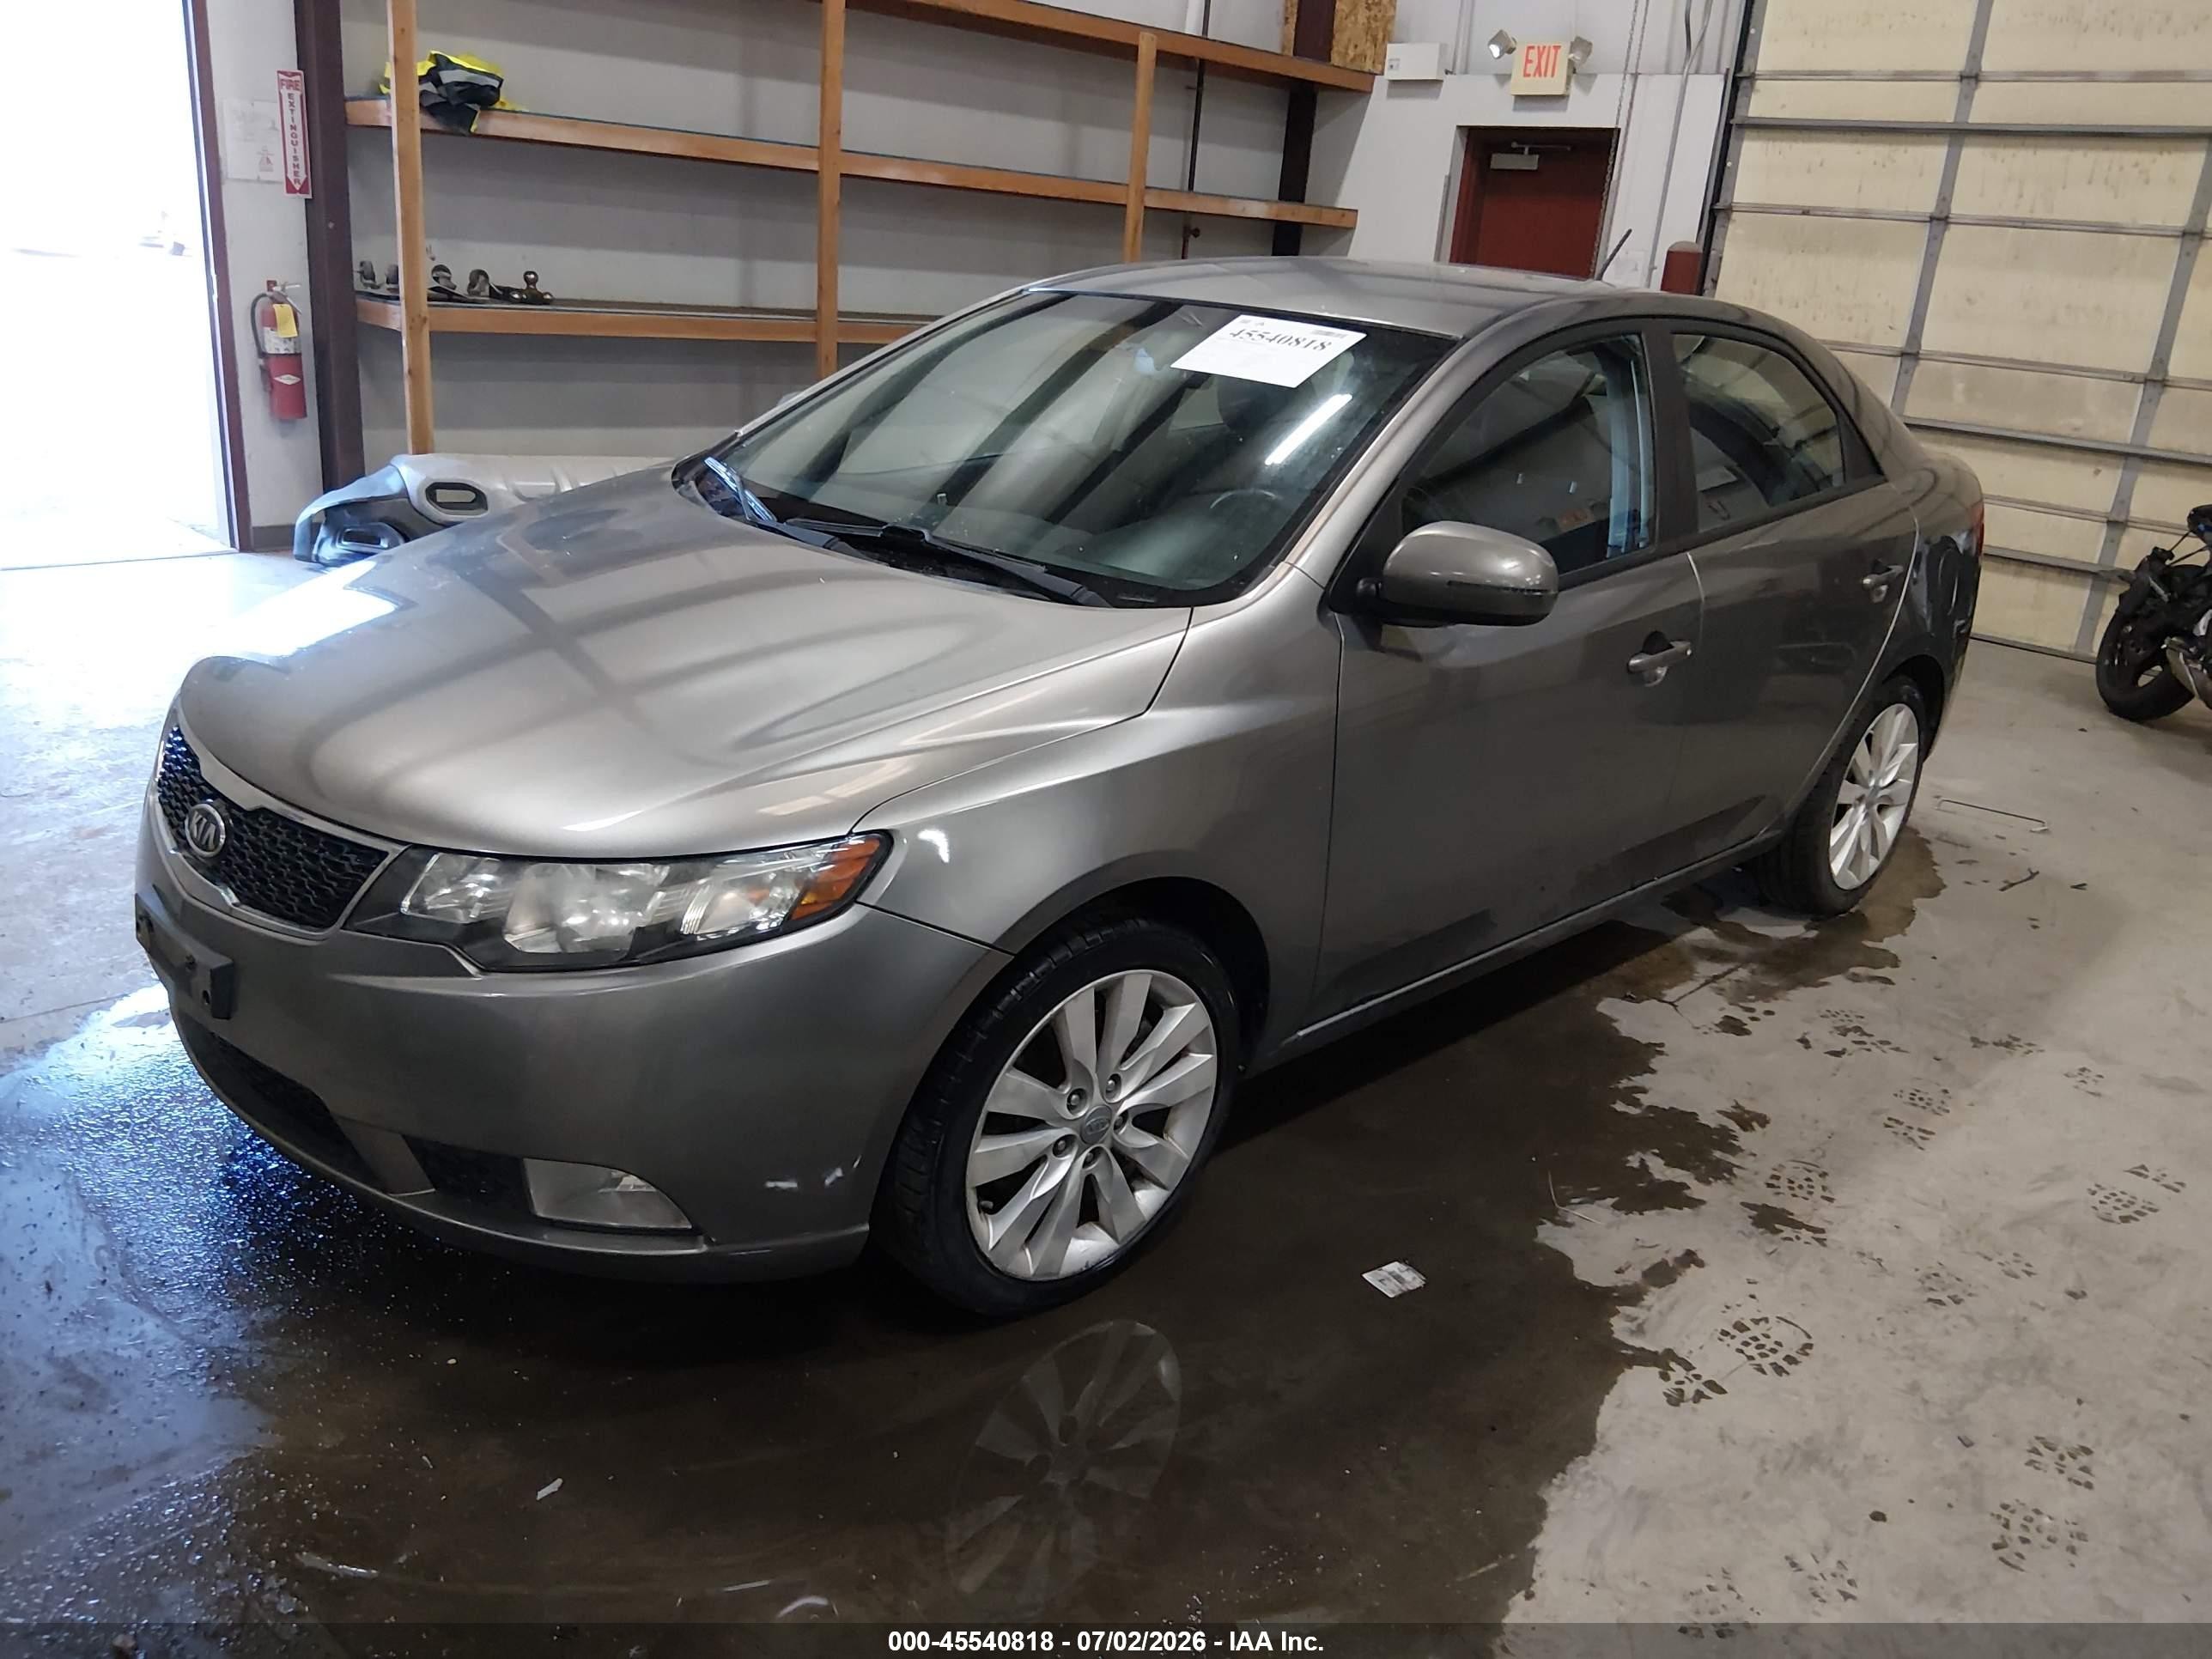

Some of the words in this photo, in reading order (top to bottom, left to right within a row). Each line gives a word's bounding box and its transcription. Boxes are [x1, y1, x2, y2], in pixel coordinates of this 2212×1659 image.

[1522, 45, 1562, 78] EXIT
[279, 78, 301, 91] FIRE
[287, 92, 302, 185] EXTINGUISHER
[1230, 328, 1333, 351] 45540818
[190, 810, 216, 851] KIA
